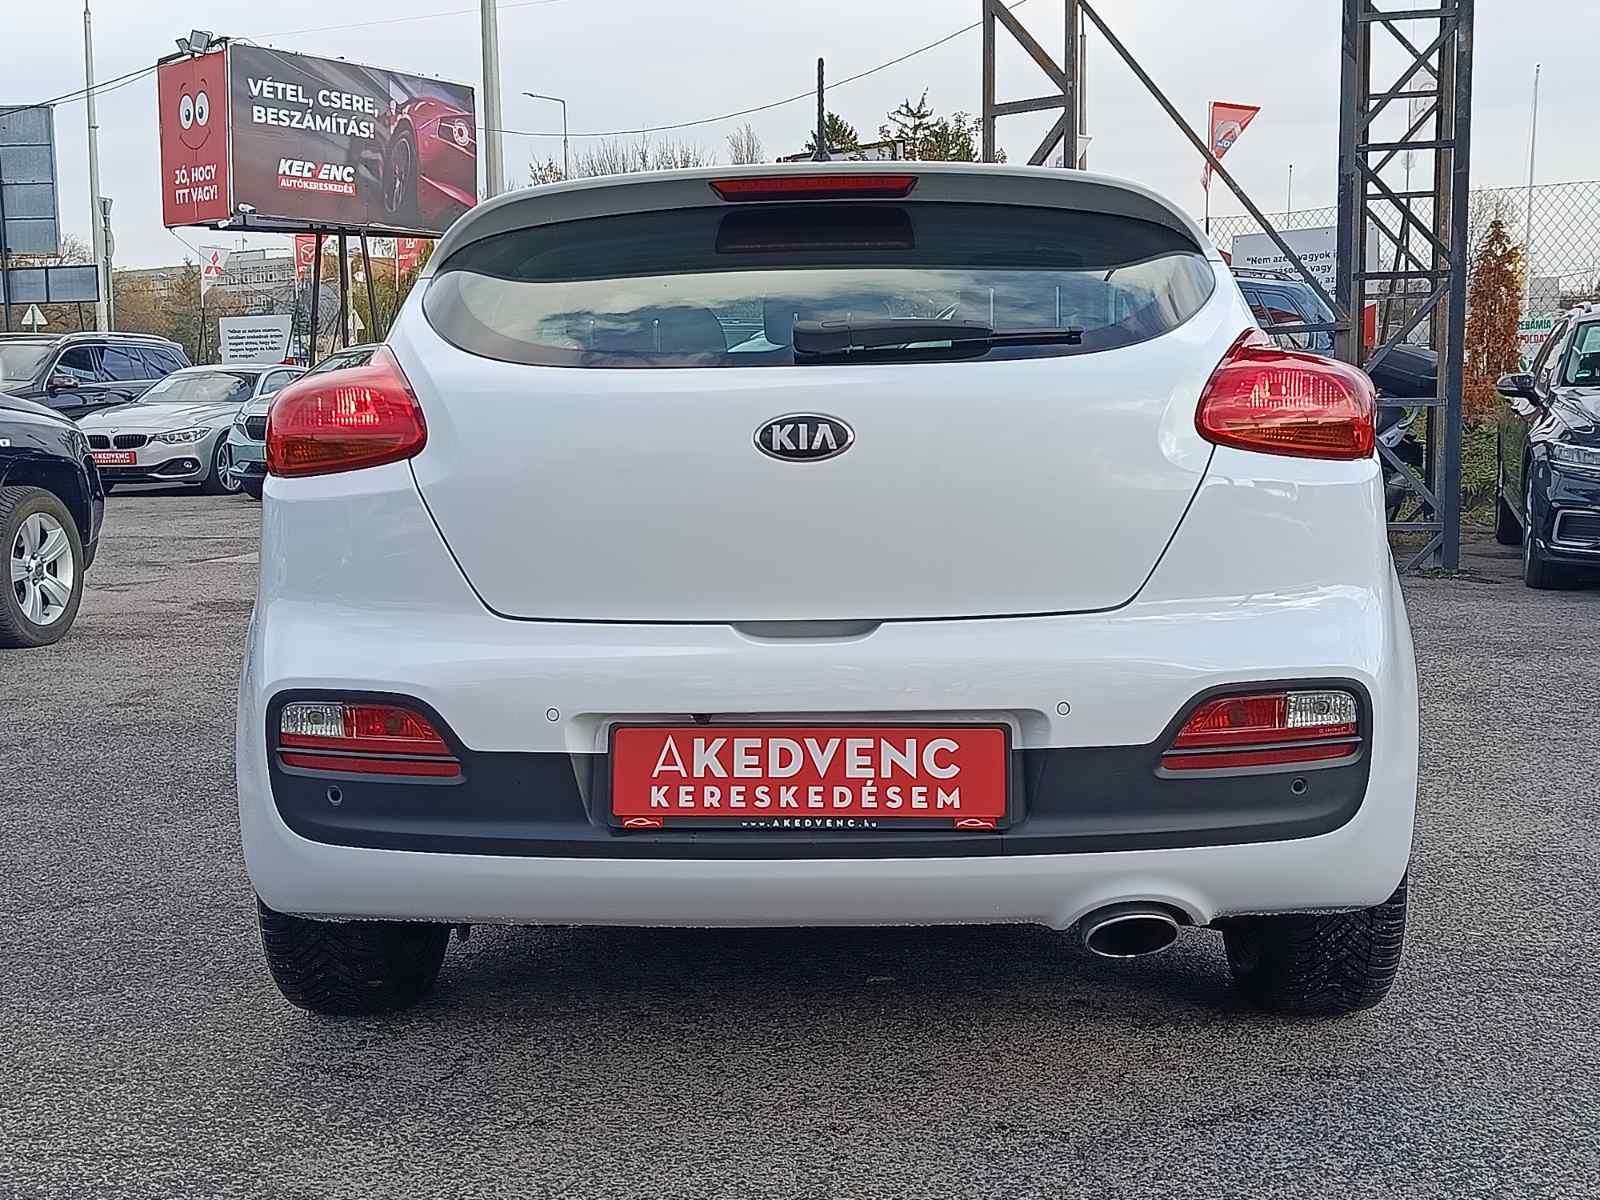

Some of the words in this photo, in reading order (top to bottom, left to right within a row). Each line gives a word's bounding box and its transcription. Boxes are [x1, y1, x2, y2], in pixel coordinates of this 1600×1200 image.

[248, 76, 314, 107] VÉTEL,
[318, 90, 378, 117] CSERE,
[252, 106, 375, 138] BESZÁMÍTÁS!
[175, 165, 189, 186] JÓ,
[191, 164, 217, 182] HOGY
[176, 189, 190, 204] ITT
[191, 185, 218, 202] VAGY!
[1310, 264, 1332, 273] vagy
[771, 423, 837, 450] KIA
[651, 734, 961, 779] AKEDVENC
[650, 780, 961, 808] KERESKEDÉSEM
[741, 819, 877, 828] www.AKEDVENC.hu
